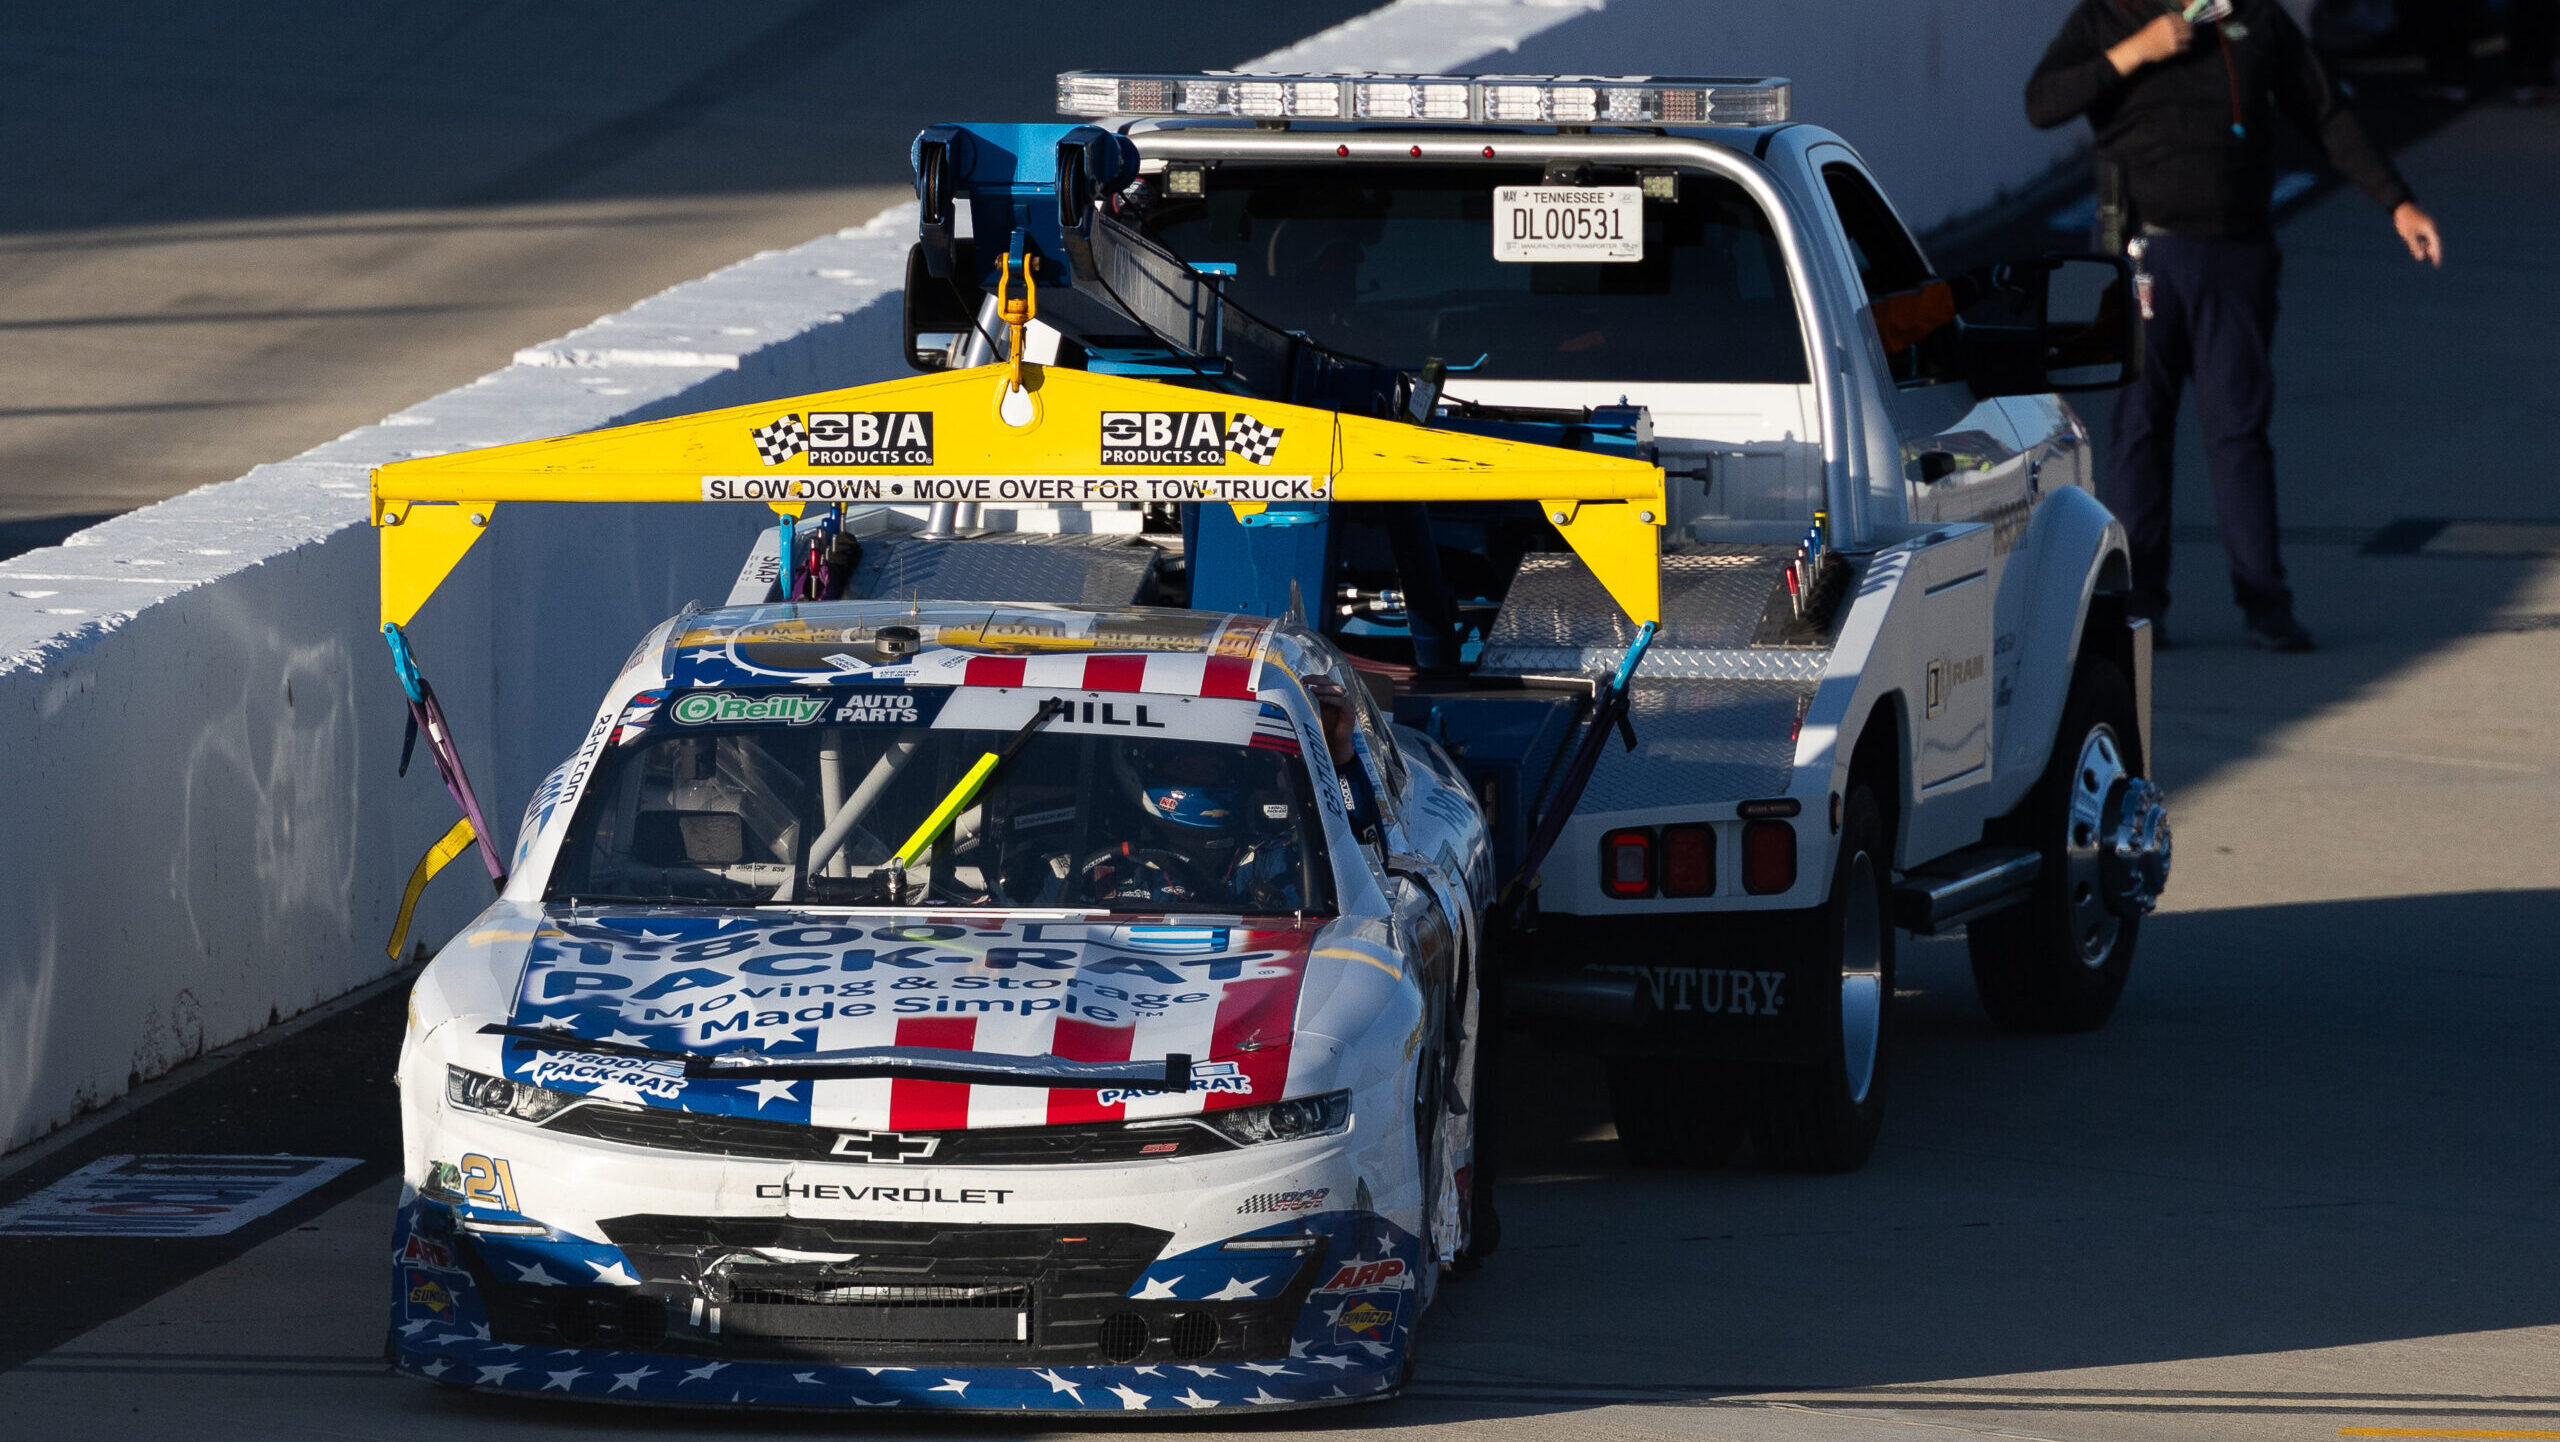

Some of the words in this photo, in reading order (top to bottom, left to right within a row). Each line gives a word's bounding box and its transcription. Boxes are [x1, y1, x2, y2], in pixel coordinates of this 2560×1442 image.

[1503, 191, 1517, 202] MAY
[1534, 192, 1605, 204] TENNESSEE
[1513, 208, 1624, 240] DL00531
[852, 413, 928, 449] B/A
[1145, 412, 1221, 449] B/A
[809, 450, 899, 464] PRODUCTS
[1102, 450, 1193, 463] PRODUCTS
[710, 480, 790, 499] SLOW
[800, 480, 881, 499] DOWN
[914, 480, 991, 499] MOVE
[999, 479, 1074, 499] OVER
[1084, 479, 1139, 499] FOR
[1146, 479, 1209, 499] TOW
[1216, 479, 1328, 499] TRUCKS
[755, 555, 781, 584] SNAP
[676, 692, 826, 723] O'Reilly
[844, 694, 915, 708] AUTO
[835, 708, 919, 722] PARTS
[1039, 699, 1166, 728] HILL
[643, 978, 877, 1021] Moving
[890, 976, 939, 990] &
[951, 975, 1210, 1010] Storage
[1584, 963, 1786, 1016] NTURY
[700, 1001, 877, 1041] Made
[1101, 1076, 1249, 1103] PACRAT
[460, 1152, 522, 1214] 21
[756, 1184, 1014, 1204] CHEVROLET
[1324, 1259, 1405, 1291] ARP
[413, 1287, 450, 1303] SUN
[1339, 1308, 1391, 1326] SUNOCO
